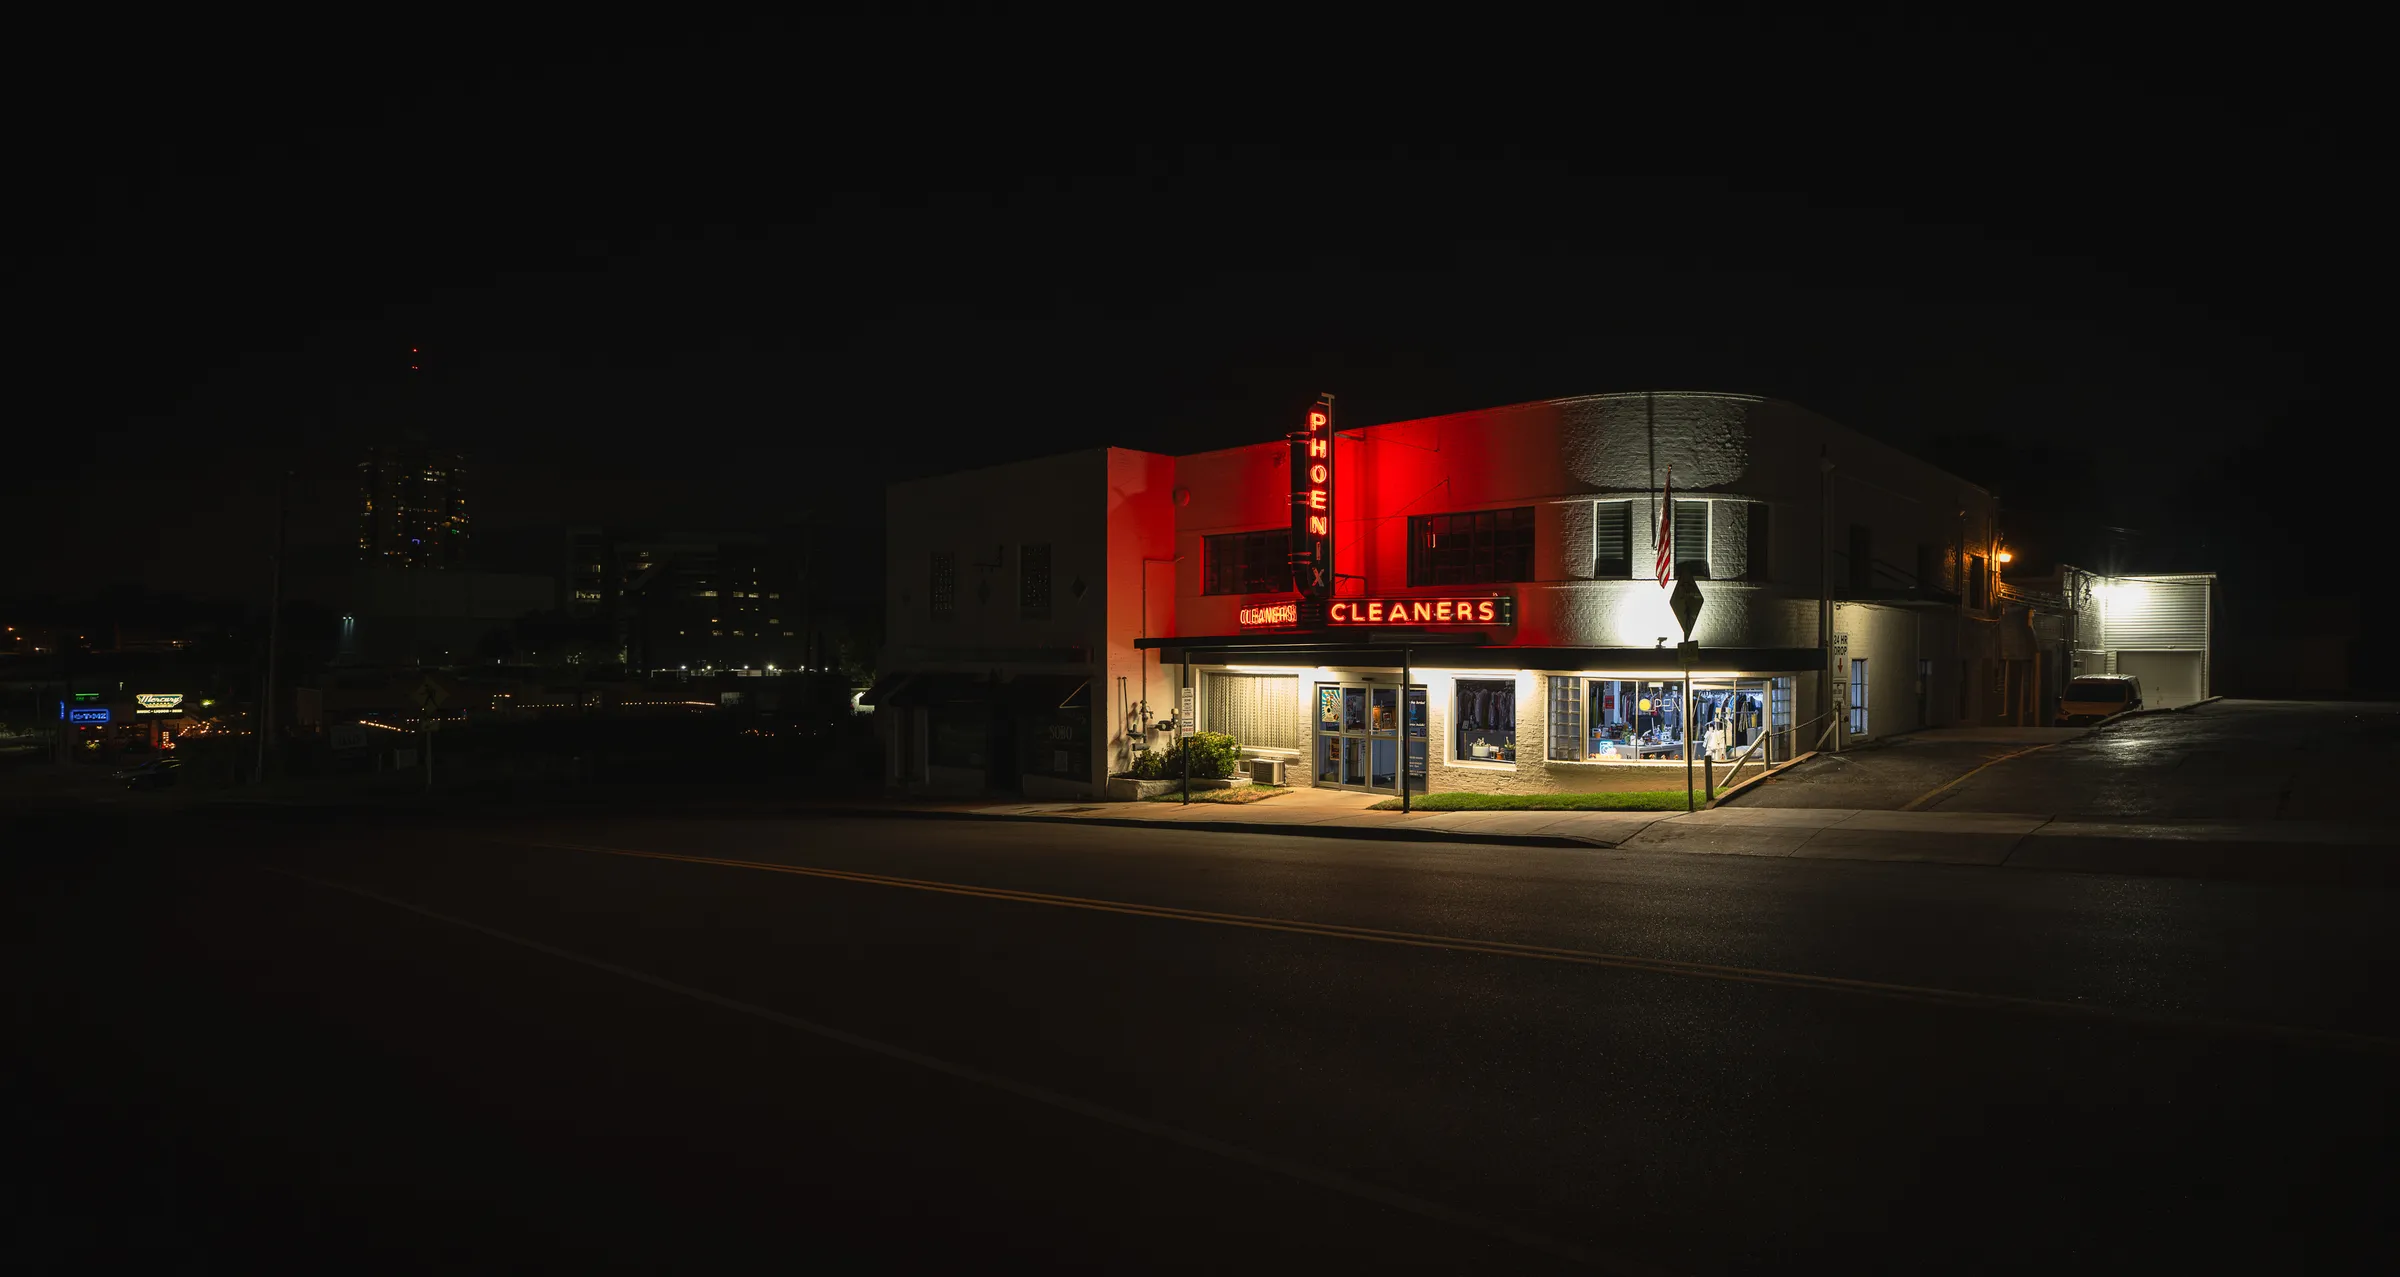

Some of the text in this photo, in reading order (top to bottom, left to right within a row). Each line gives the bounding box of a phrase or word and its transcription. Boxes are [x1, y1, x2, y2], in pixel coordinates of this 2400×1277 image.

[1310, 412, 1328, 588] PHOENIX
[1330, 602, 1495, 622] CLEANERS
[1833, 635, 1848, 645] 24 HR
[1833, 646, 1848, 656] DROP
